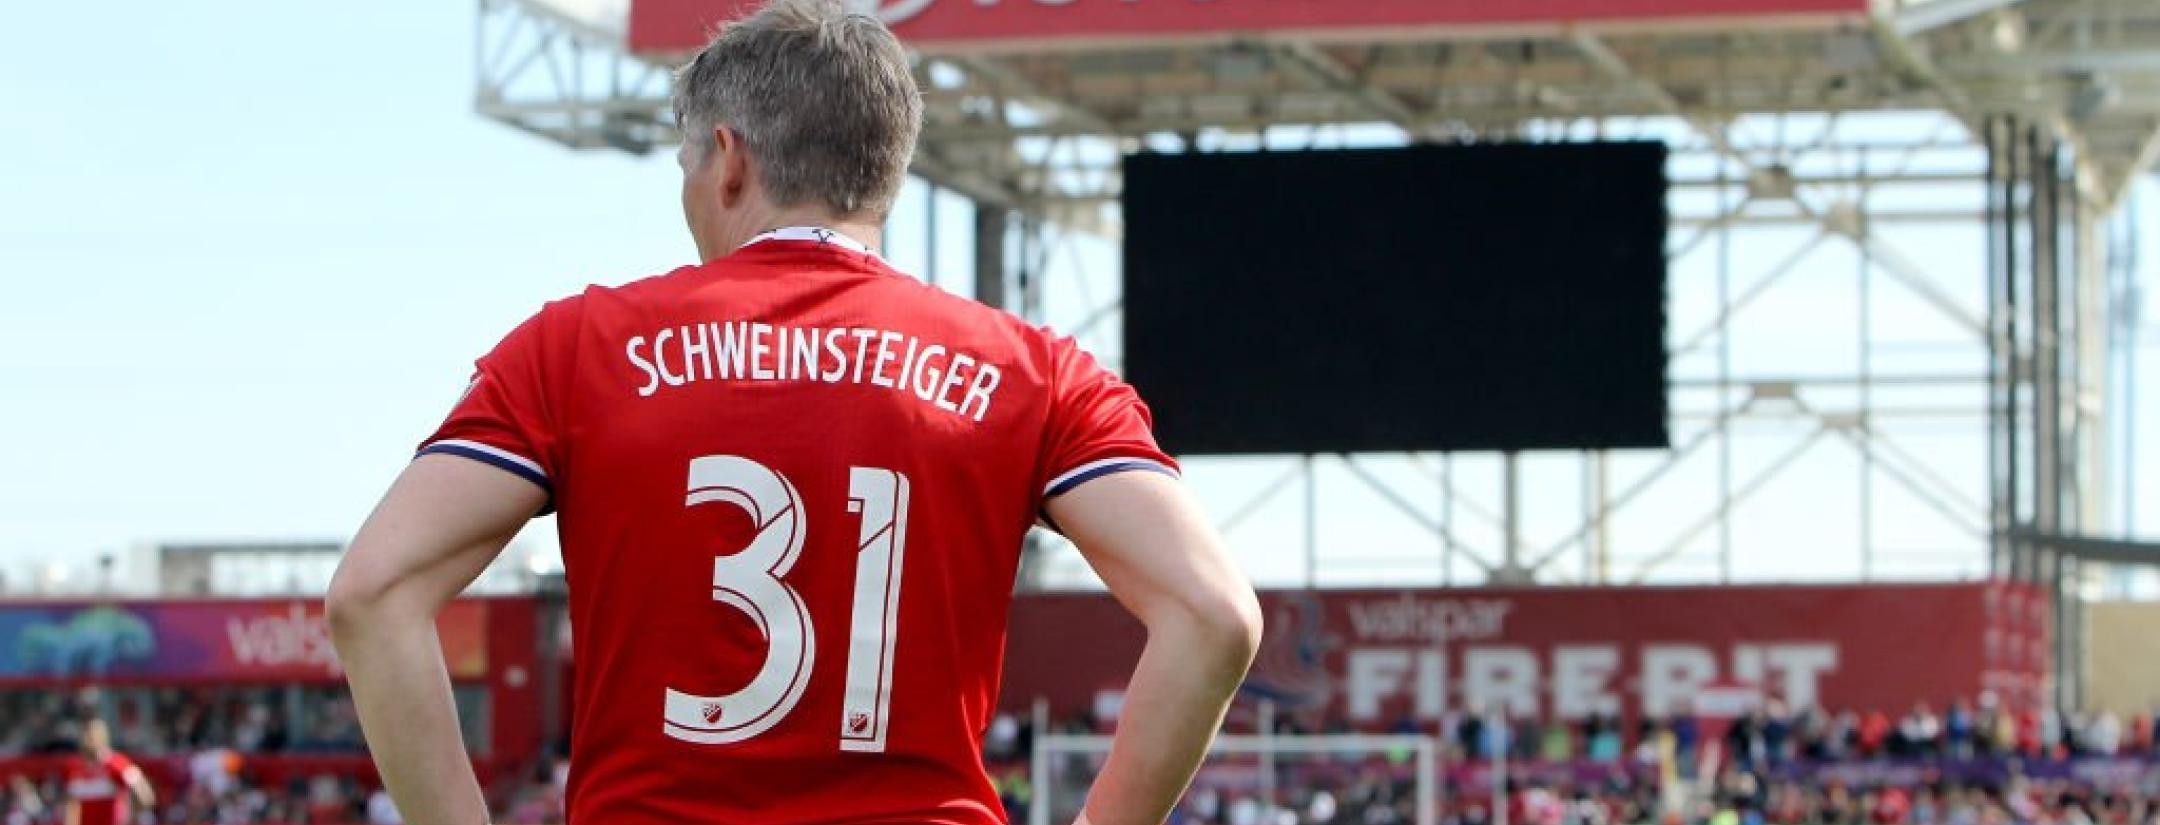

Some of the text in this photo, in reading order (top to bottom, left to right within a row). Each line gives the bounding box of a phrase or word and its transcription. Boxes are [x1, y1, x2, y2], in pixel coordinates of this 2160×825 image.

[626, 321, 1000, 422] SCHWEINSTEIGER
[663, 454, 910, 753] 31
[1348, 645, 1621, 718] FIRE
